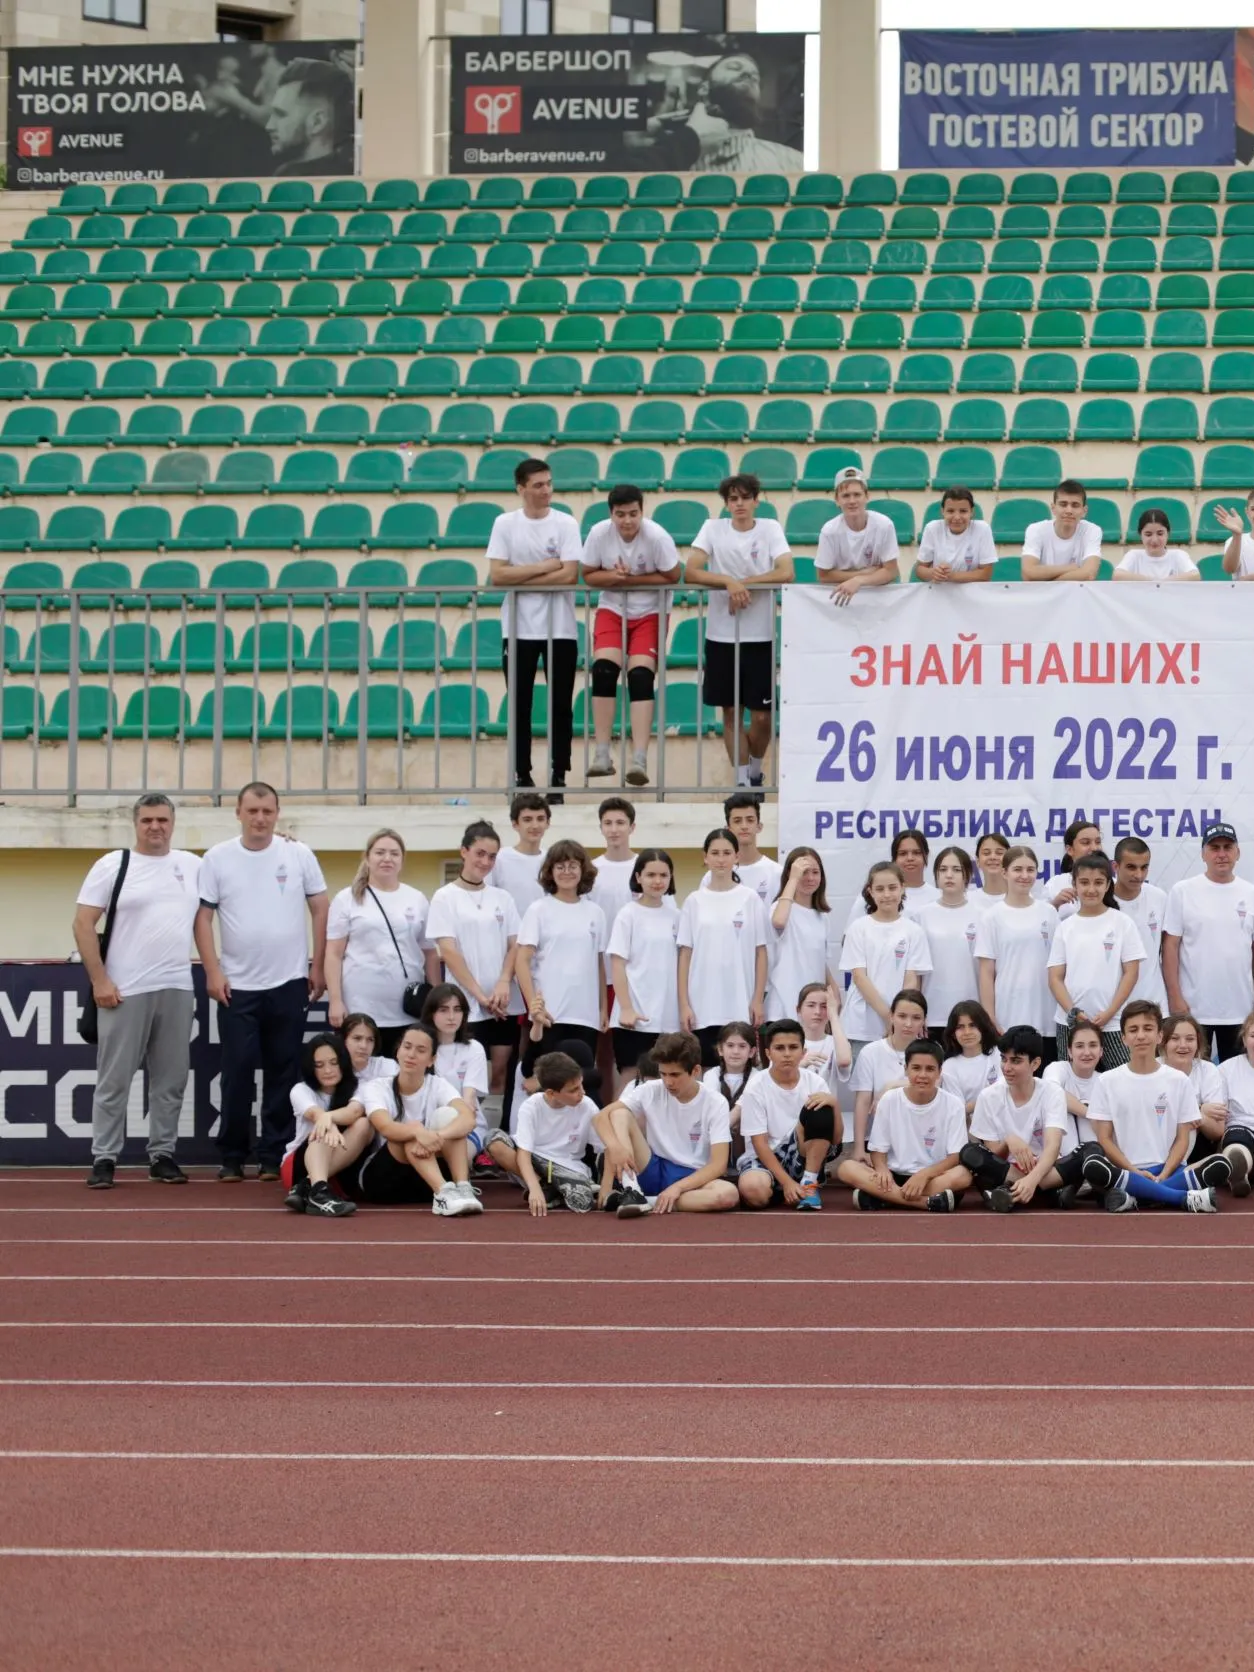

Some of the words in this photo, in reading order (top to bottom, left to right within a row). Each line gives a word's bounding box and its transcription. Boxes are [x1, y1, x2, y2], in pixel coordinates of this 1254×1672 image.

[465, 50, 631, 72] БАРБЕРШОП
[18, 66, 74, 87] МНЕ
[83, 63, 184, 85] НУЖНА
[904, 61, 1080, 97] ВОСТОЧНАЯ
[1090, 60, 1228, 96] ТРИБУНА
[17, 94, 88, 115] ТВОЯ
[97, 91, 206, 113] ГОЛОВА
[533, 98, 639, 120] AVENUE
[928, 107, 1080, 148] ГОСТЕВОЙ
[1090, 112, 1204, 148] СЕКТОР
[59, 133, 124, 148] AVENUE
[480, 149, 606, 163] barberavenue.ru
[33, 168, 164, 183] barberavenue.ru
[850, 634, 982, 687] ЗНАЙ
[1002, 641, 1201, 685] НАШИХ!
[816, 720, 876, 782] 26
[1053, 717, 1177, 781] 2022
[815, 809, 1036, 840] РЕСПУБЛИКА
